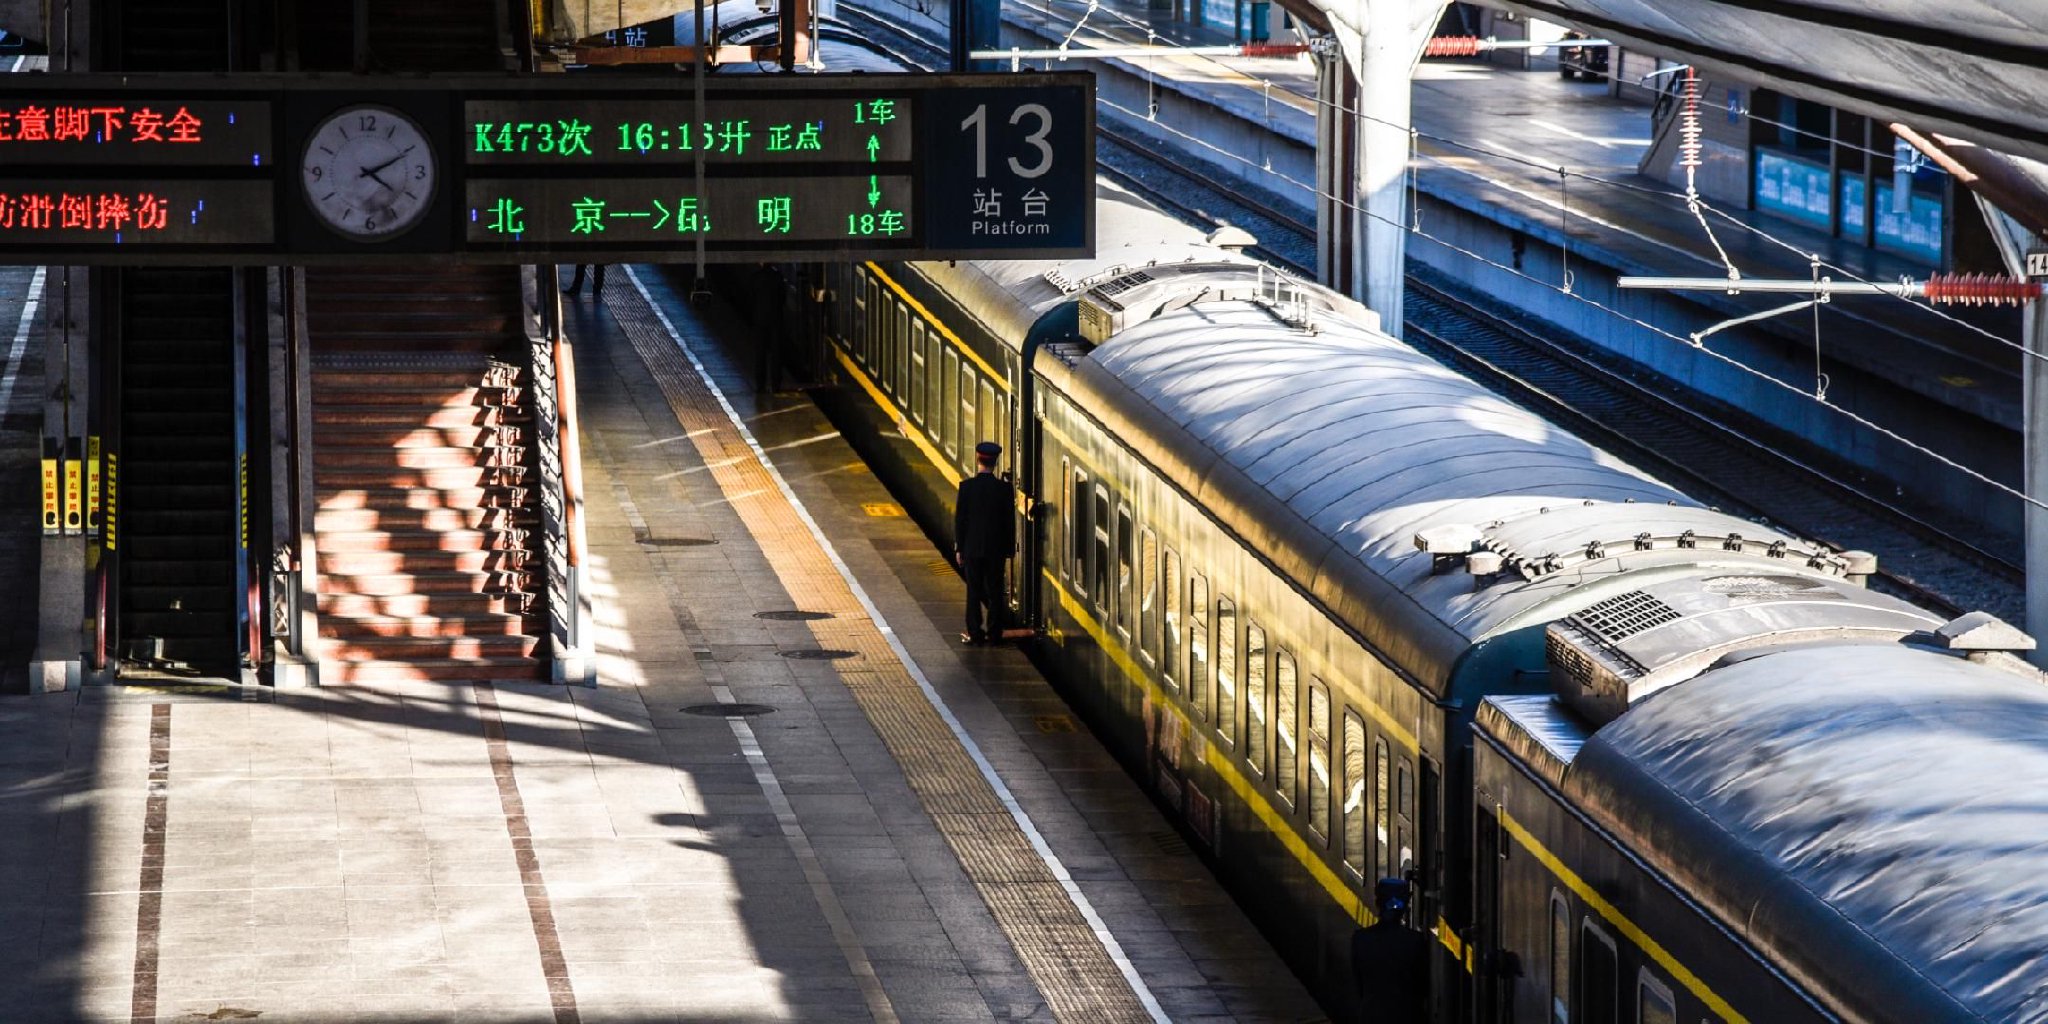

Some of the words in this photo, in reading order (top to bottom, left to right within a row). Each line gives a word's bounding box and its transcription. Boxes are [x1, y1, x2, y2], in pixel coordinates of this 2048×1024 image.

[854, 98, 896, 125] 1车
[360, 115, 377, 132] 12
[474, 117, 593, 156] K473次
[766, 121, 822, 151] 正点
[961, 103, 1053, 179] 13
[311, 166, 322, 182] 9
[415, 164, 426, 180] 3
[365, 216, 377, 231] 6
[848, 209, 905, 236] 18车
[972, 220, 1050, 235] Platform
